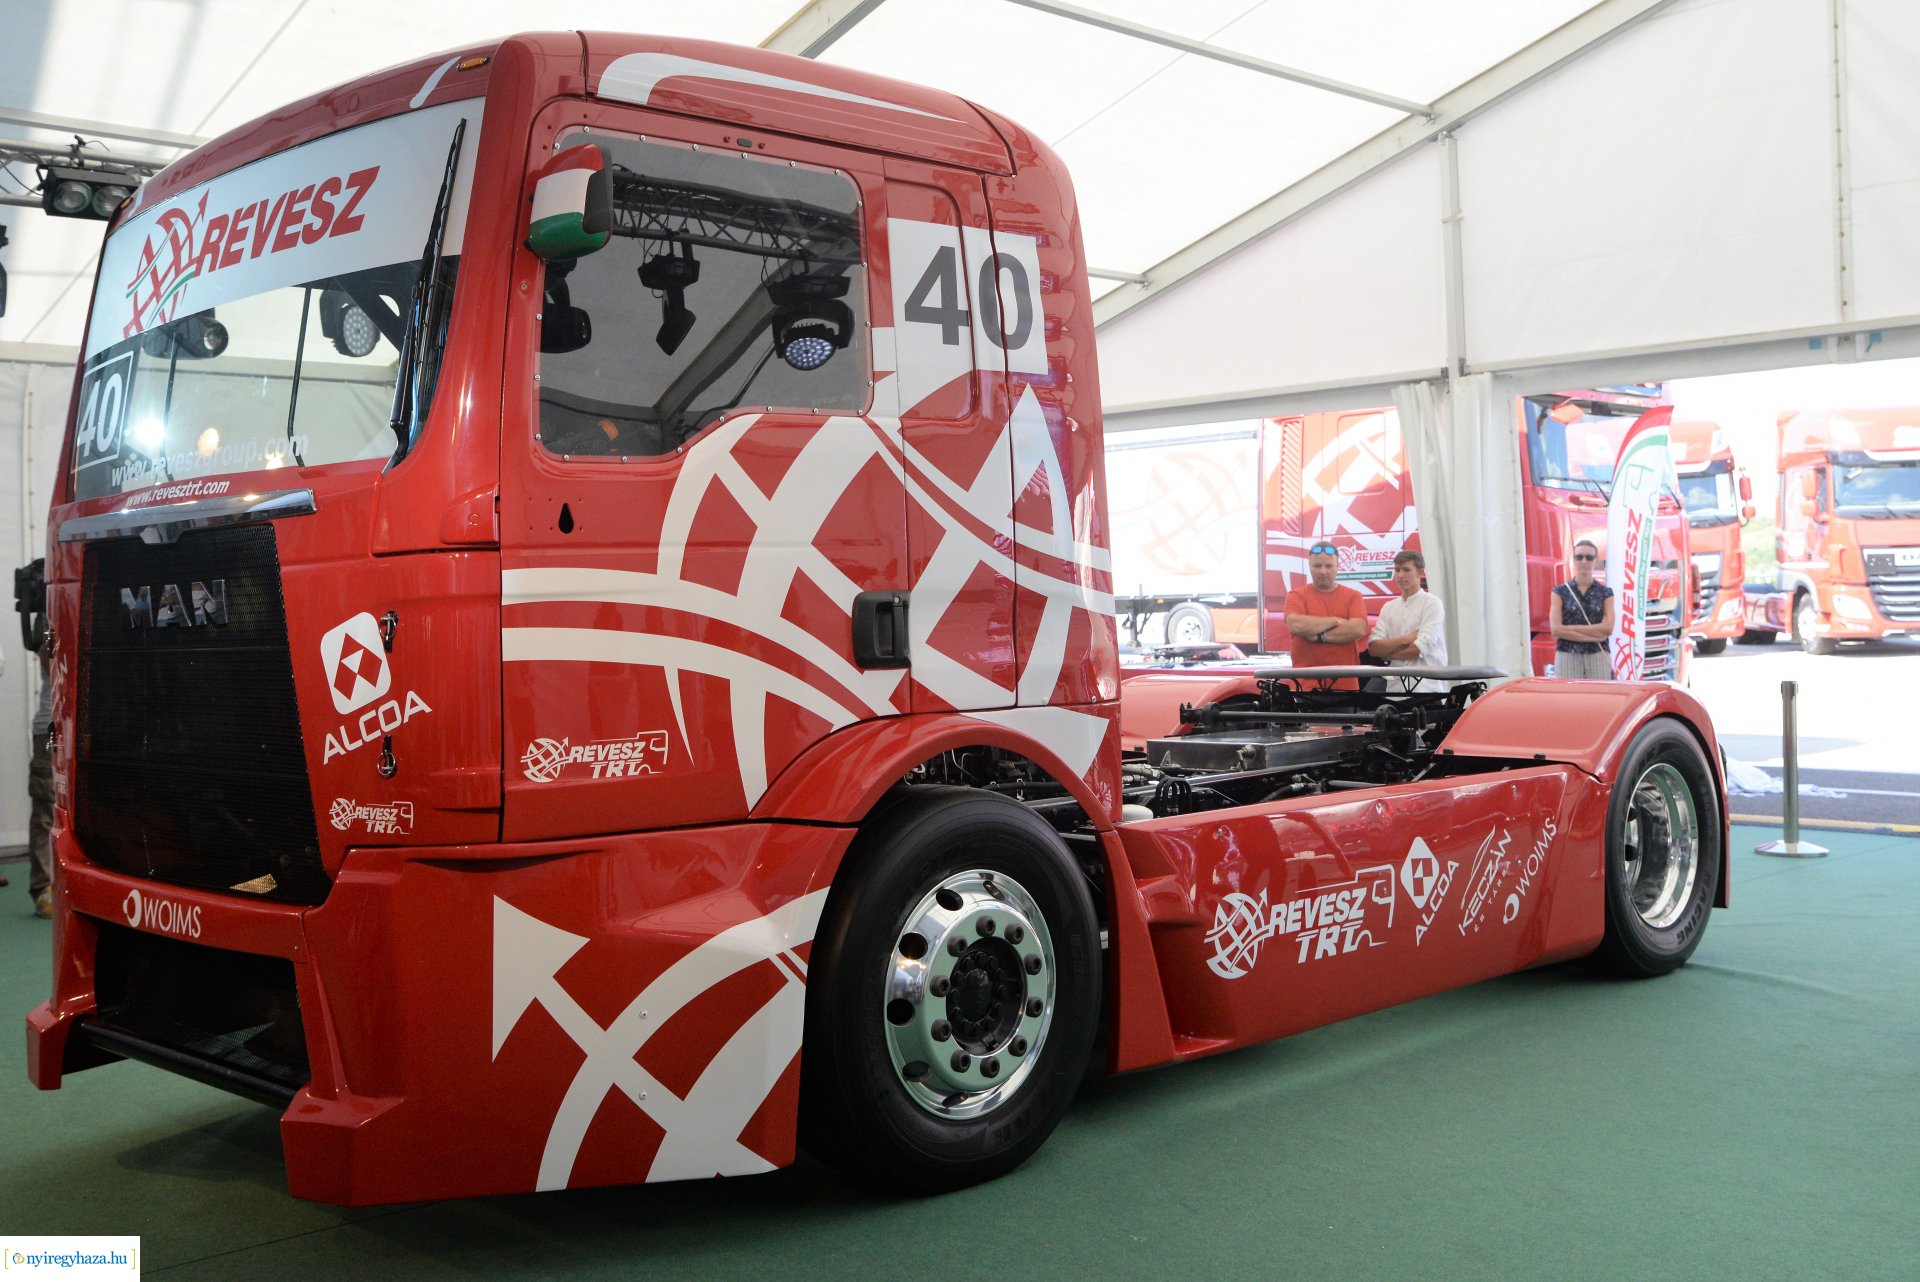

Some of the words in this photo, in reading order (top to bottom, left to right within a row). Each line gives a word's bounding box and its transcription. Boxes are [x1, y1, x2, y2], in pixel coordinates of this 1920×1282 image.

[194, 165, 381, 276] REVESZ
[904, 245, 1034, 351] 40
[77, 373, 123, 458] 40
[111, 434, 309, 487] www.reveszgroup.com
[126, 479, 230, 507] www.revesztrt.com
[1355, 551, 1396, 561] REVESZ
[1621, 508, 1642, 639] REVESZ
[121, 579, 231, 629] MAN
[322, 690, 433, 765] ALCOA
[568, 741, 646, 763] REVESZ
[355, 806, 399, 821] REVESZ
[1516, 816, 1557, 897] WOIMS
[143, 896, 202, 938] WOIMS
[1268, 887, 1368, 937] REVESZ
[1415, 860, 1460, 947] ALCOA
